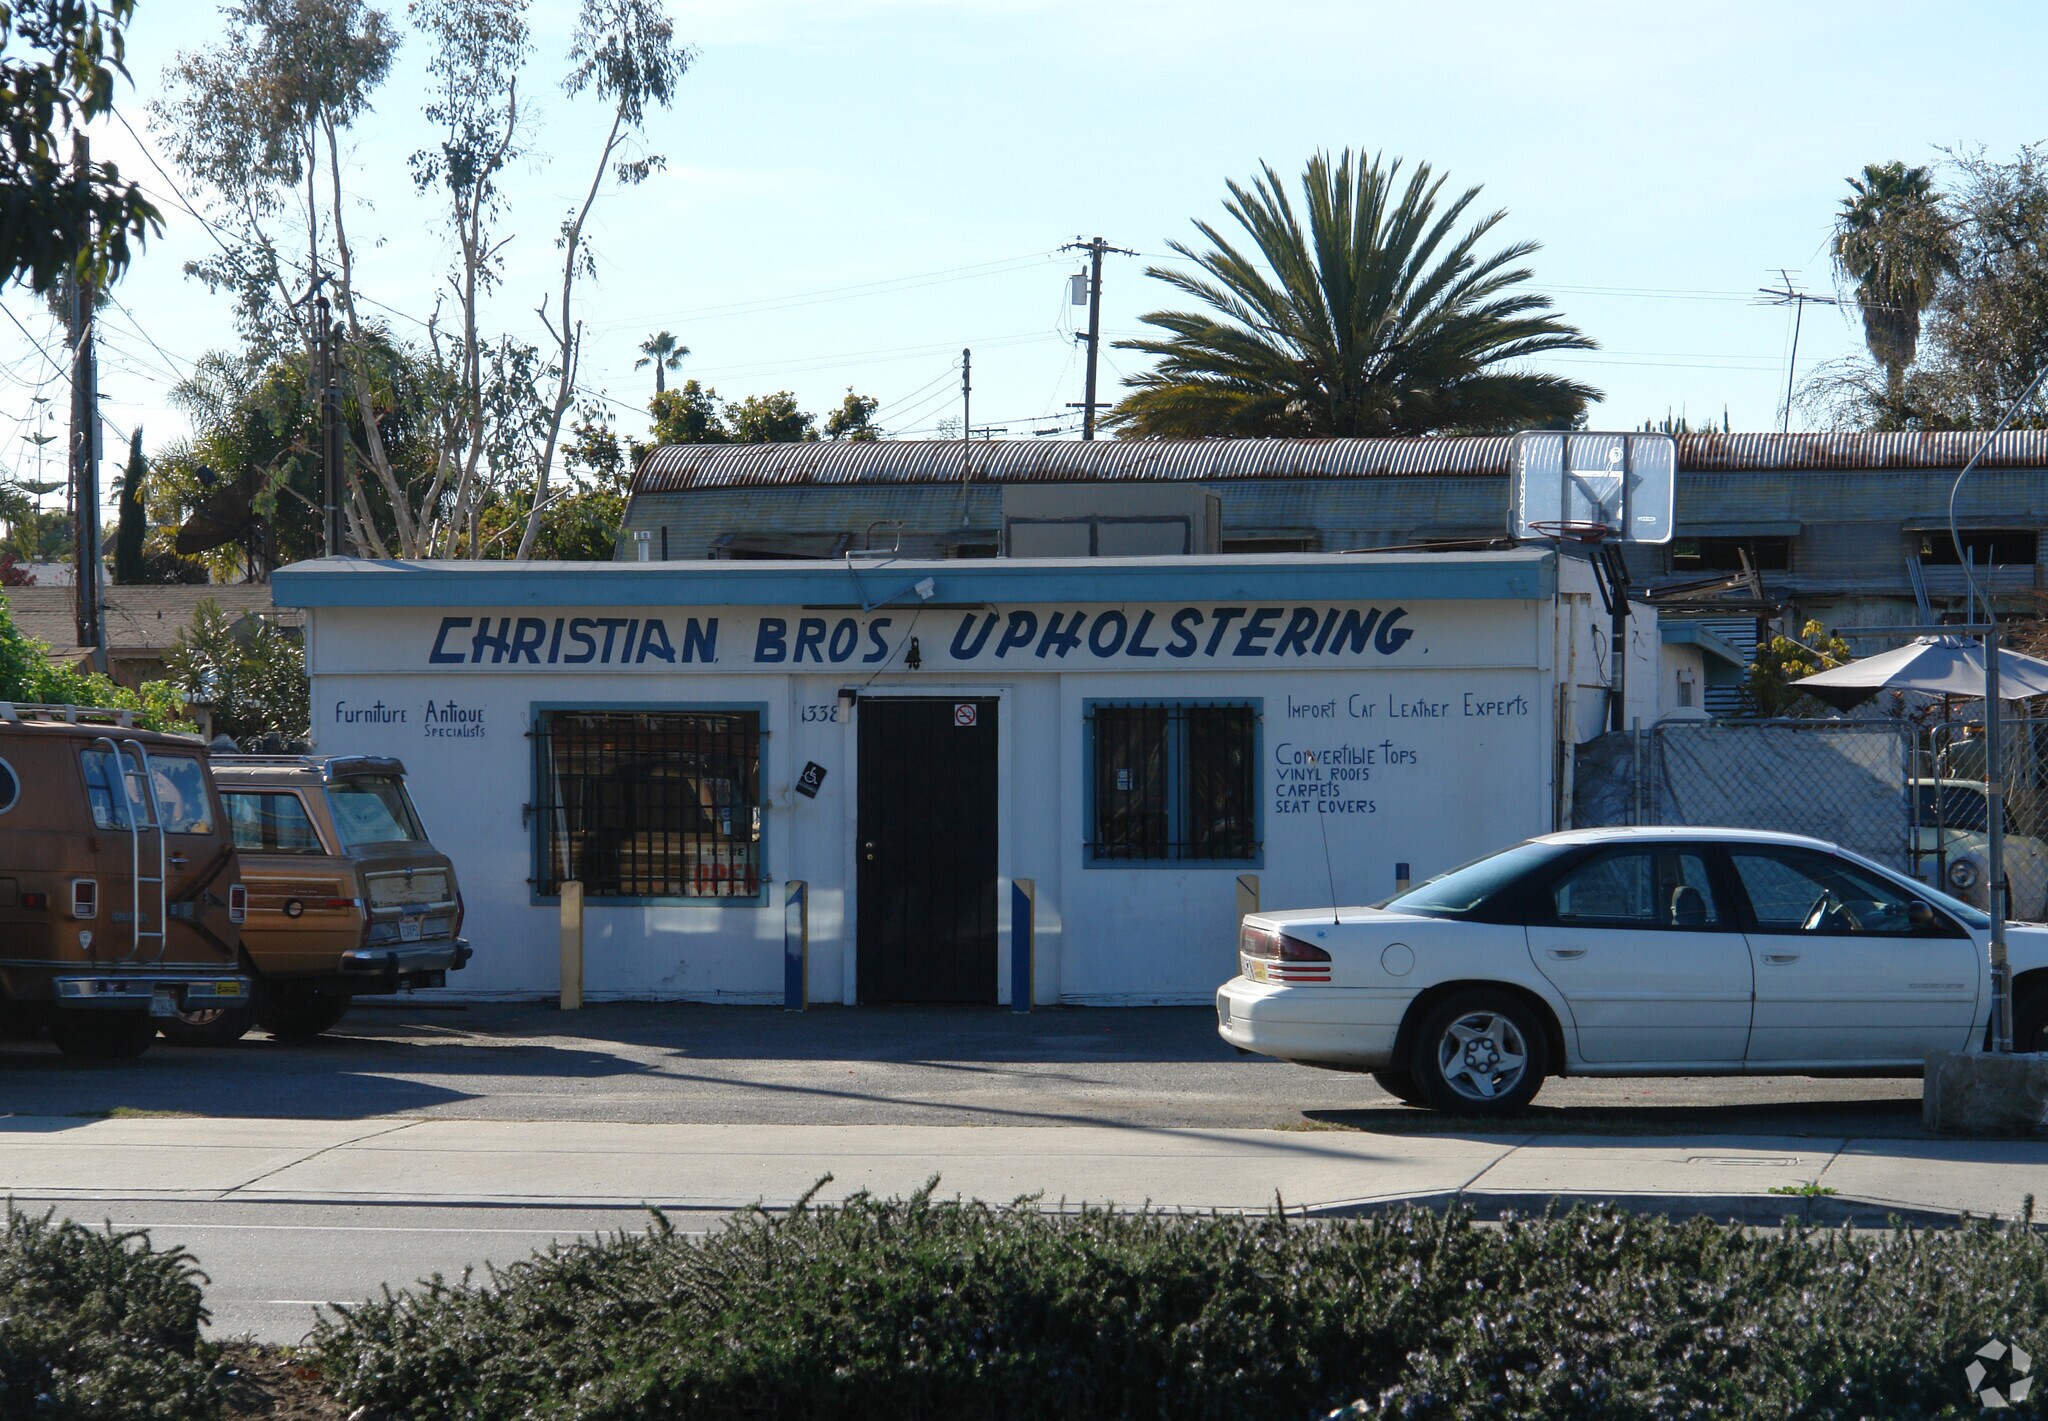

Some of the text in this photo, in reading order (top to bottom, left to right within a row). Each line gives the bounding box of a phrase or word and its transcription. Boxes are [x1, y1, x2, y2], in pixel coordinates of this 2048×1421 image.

[949, 606, 1415, 661] UPHOLSTERING
[335, 700, 407, 723] Furniture
[1287, 692, 1529, 719] Import Car Leather Experts
[424, 723, 486, 738] Specialists
[1378, 739, 1418, 765] Tops
[1276, 767, 1370, 781] VINYL ROOFS
[1275, 780, 1340, 798] CARPETS
[1275, 800, 1377, 814] SEAT COVERS
